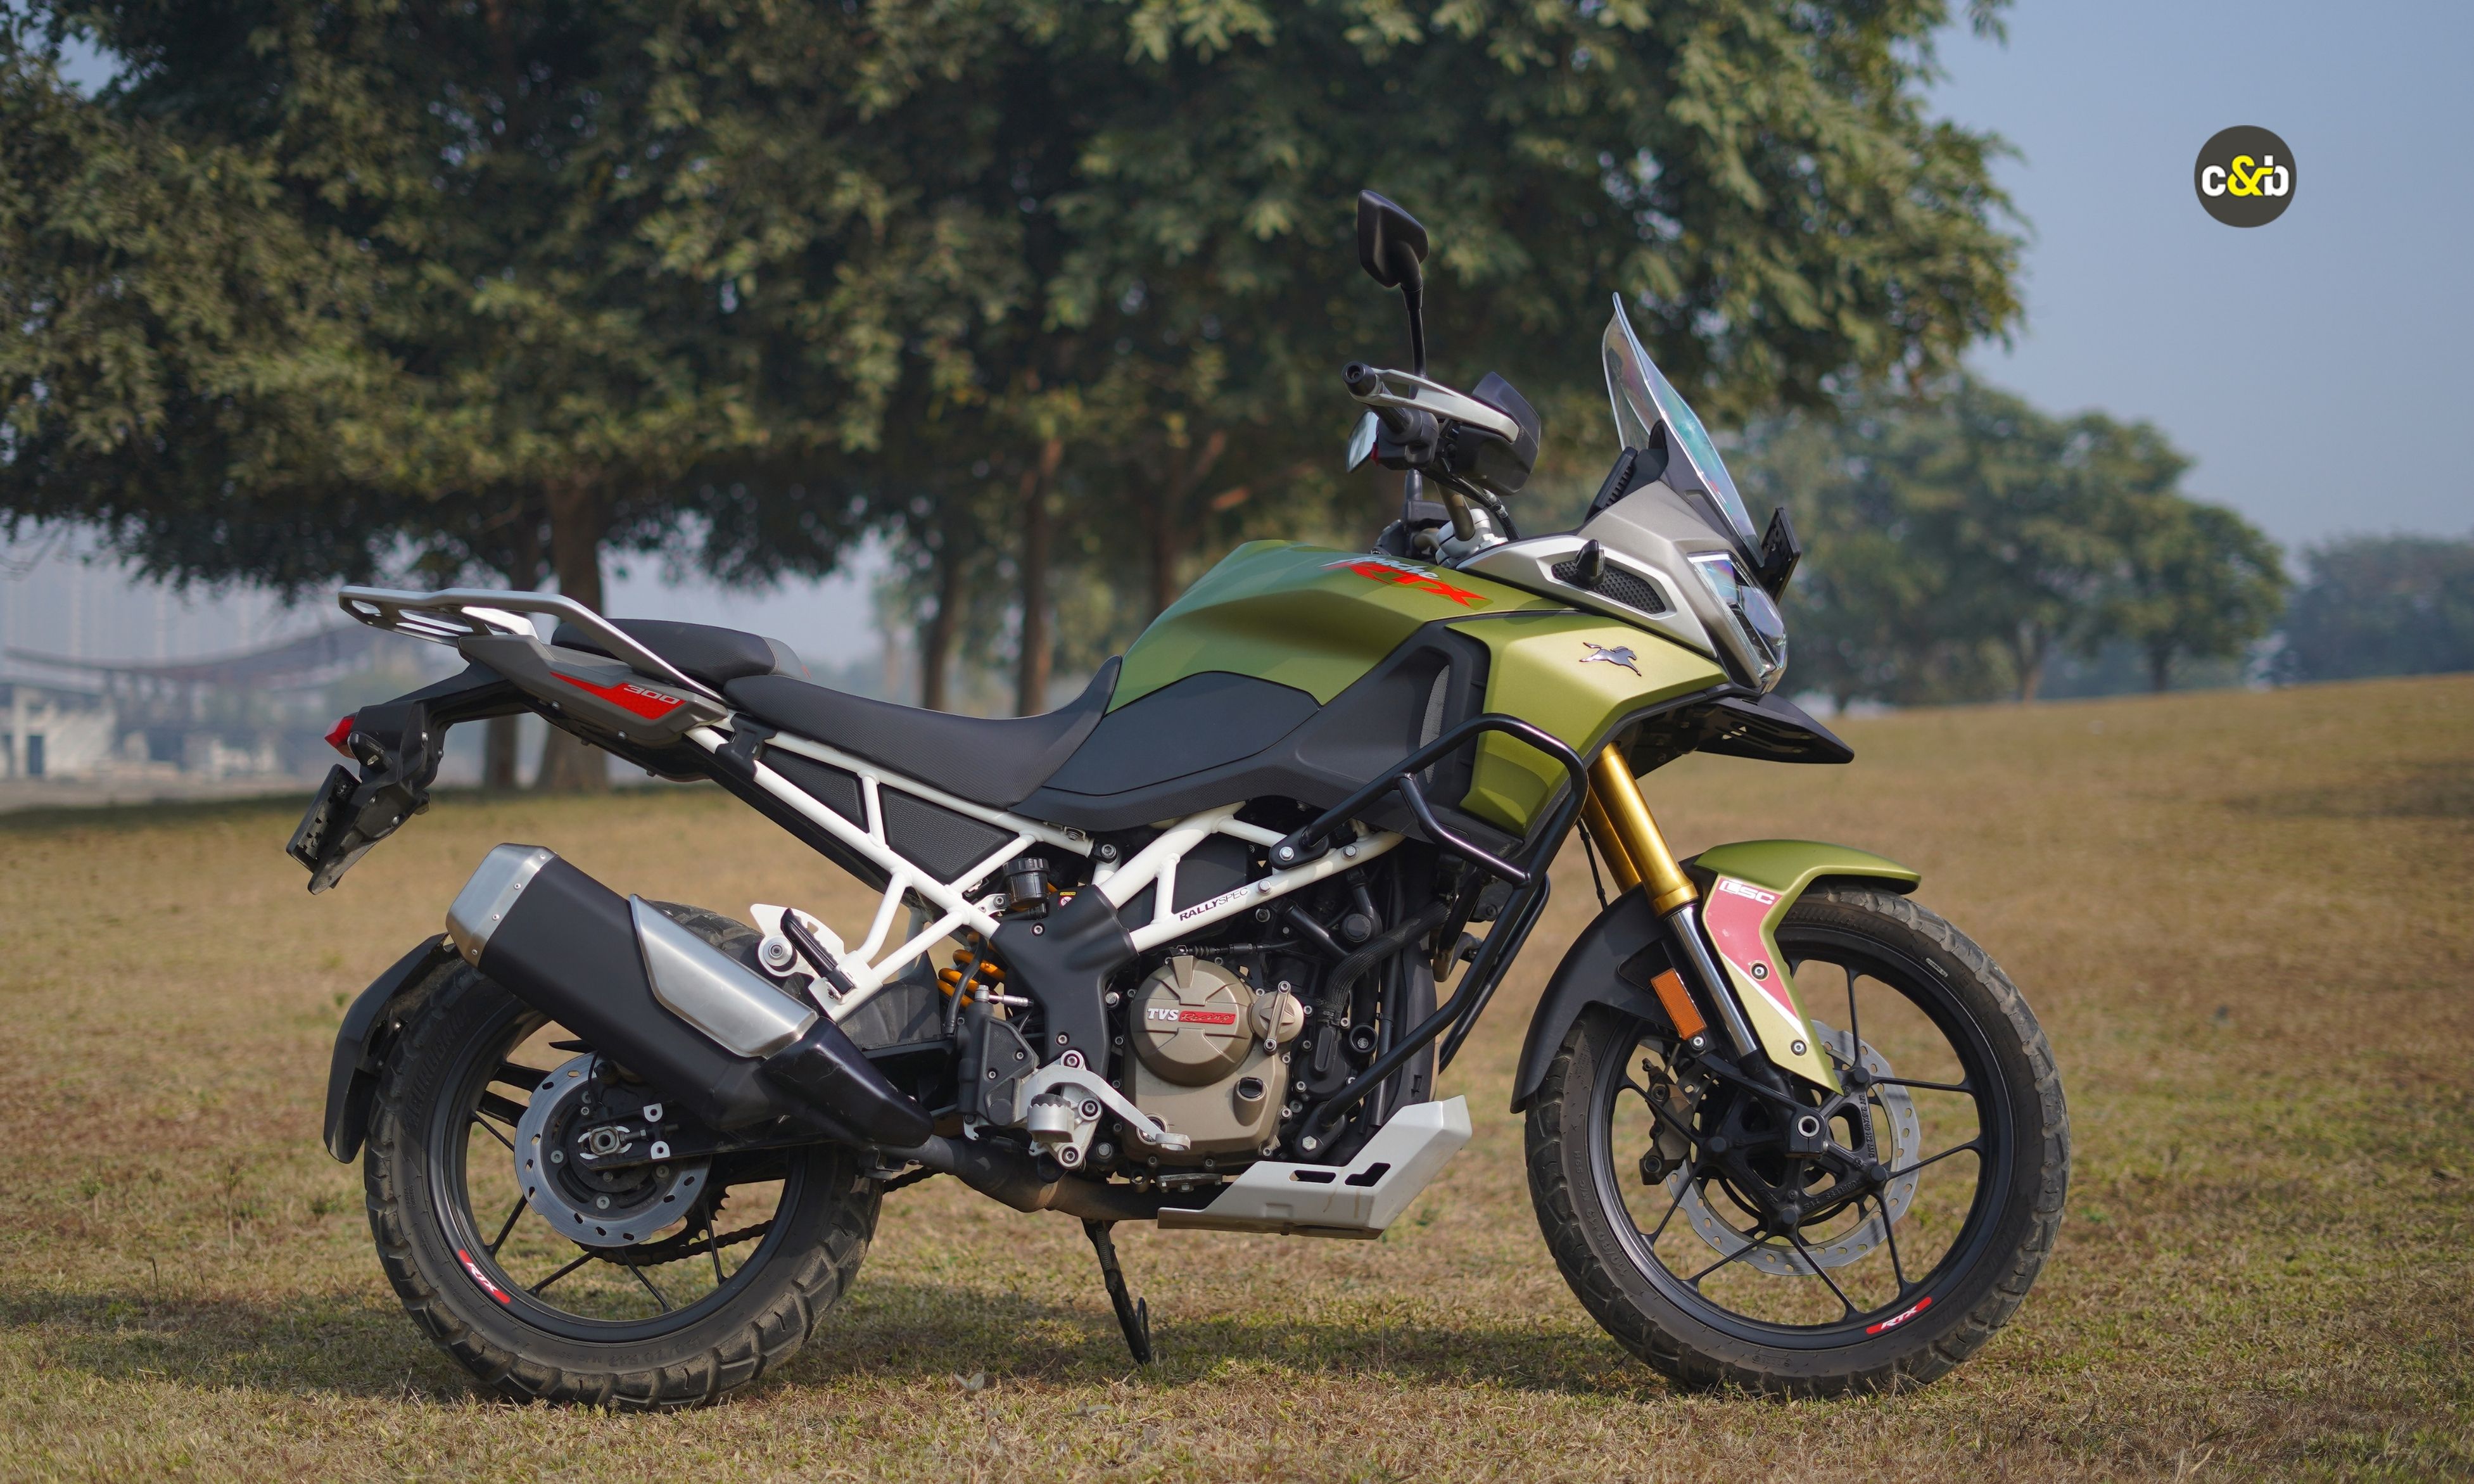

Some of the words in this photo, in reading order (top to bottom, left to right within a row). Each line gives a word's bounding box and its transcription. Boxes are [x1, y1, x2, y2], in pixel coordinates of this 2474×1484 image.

[1324, 562, 1487, 607] RTX
[623, 684, 680, 704] 300
[1147, 1008, 1179, 1021] TVS
[1181, 1012, 1230, 1022] Racing
[466, 1262, 499, 1292] RTX
[1881, 1305, 1917, 1329] RTX
